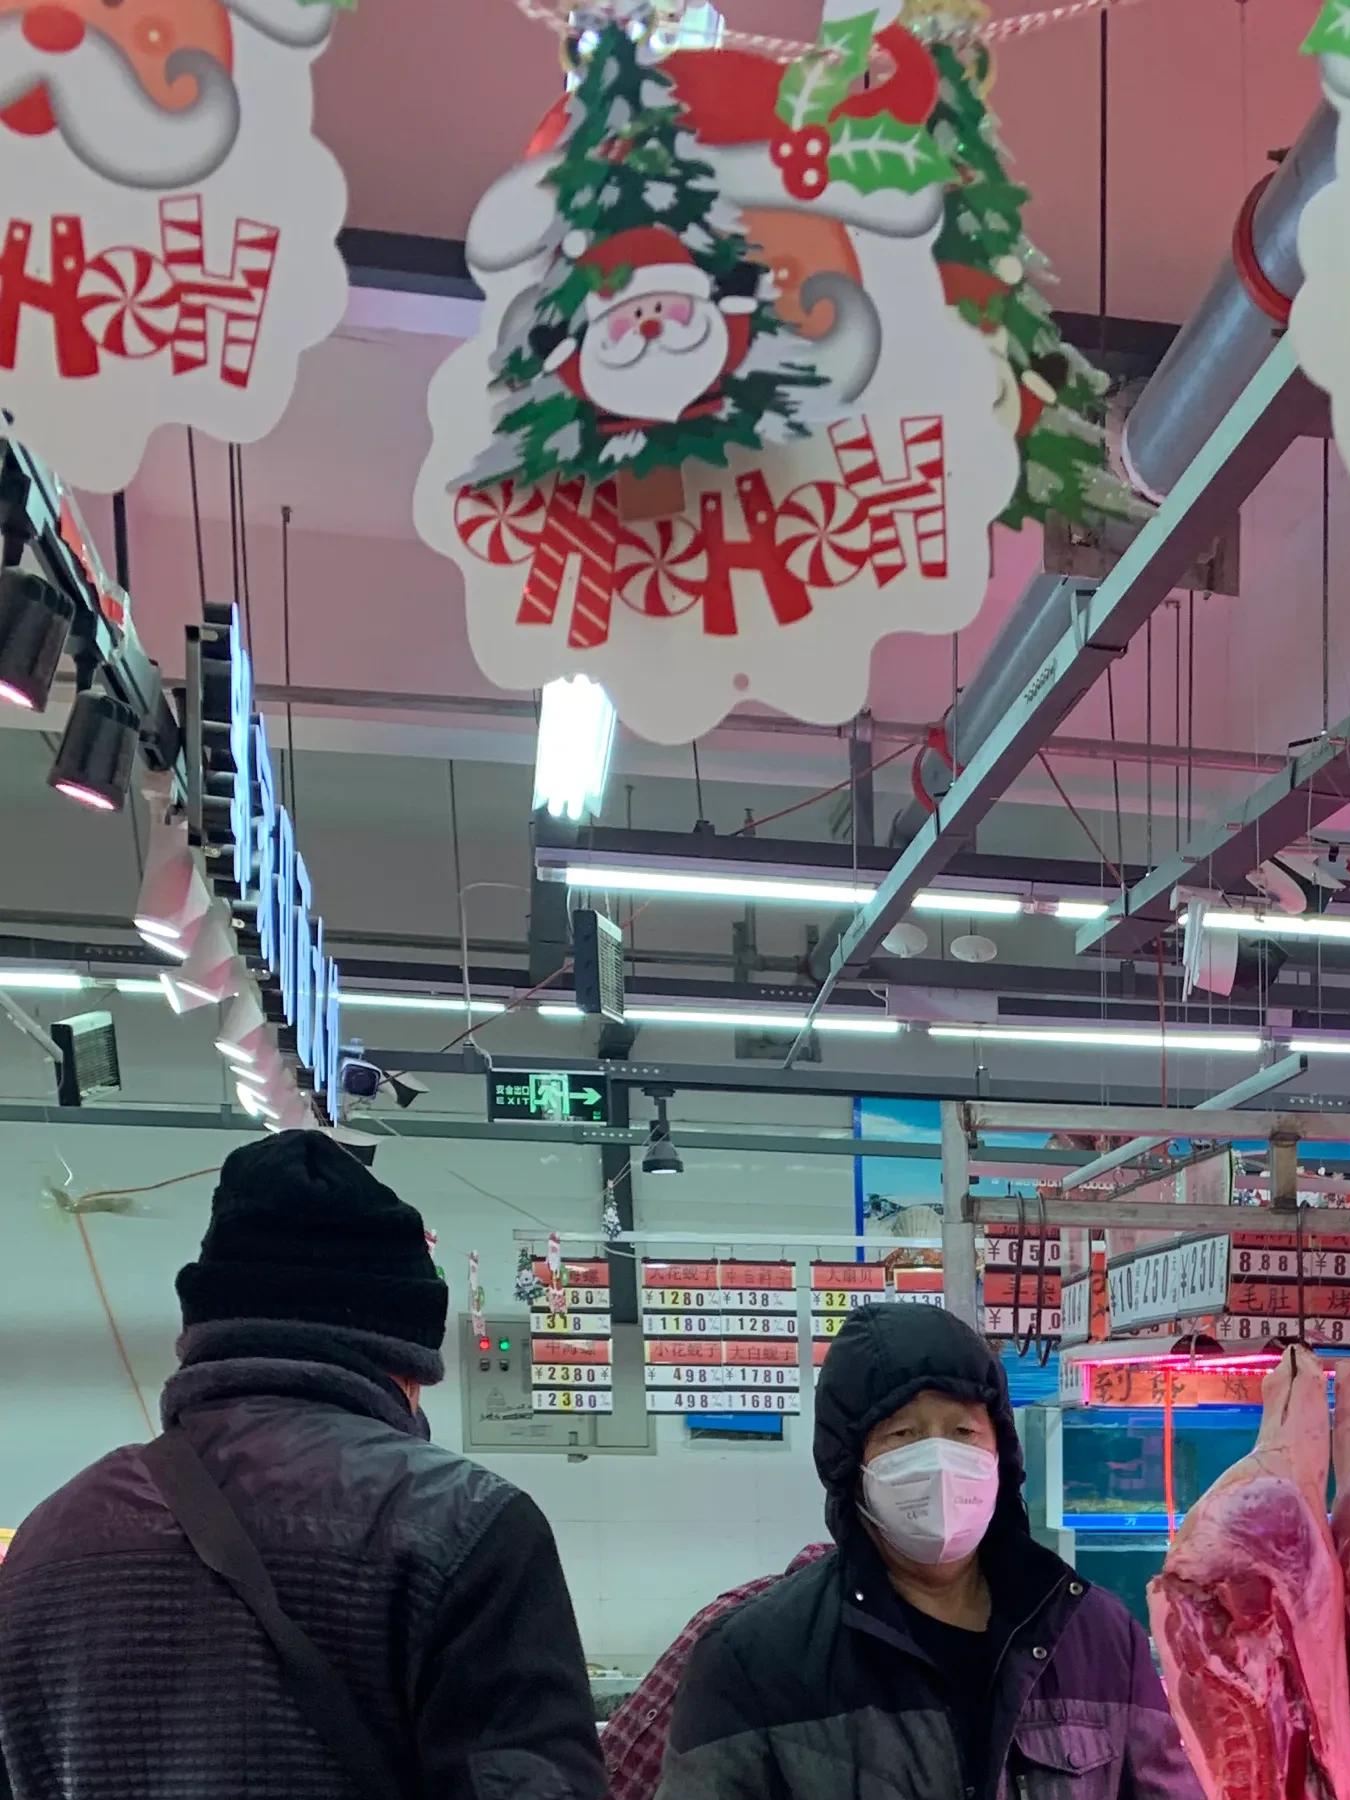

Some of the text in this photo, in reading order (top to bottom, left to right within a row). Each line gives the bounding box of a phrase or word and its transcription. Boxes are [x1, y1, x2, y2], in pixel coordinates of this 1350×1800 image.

[496, 1085, 529, 1095] 安全出口
[496, 1096, 530, 1105] EXIT
